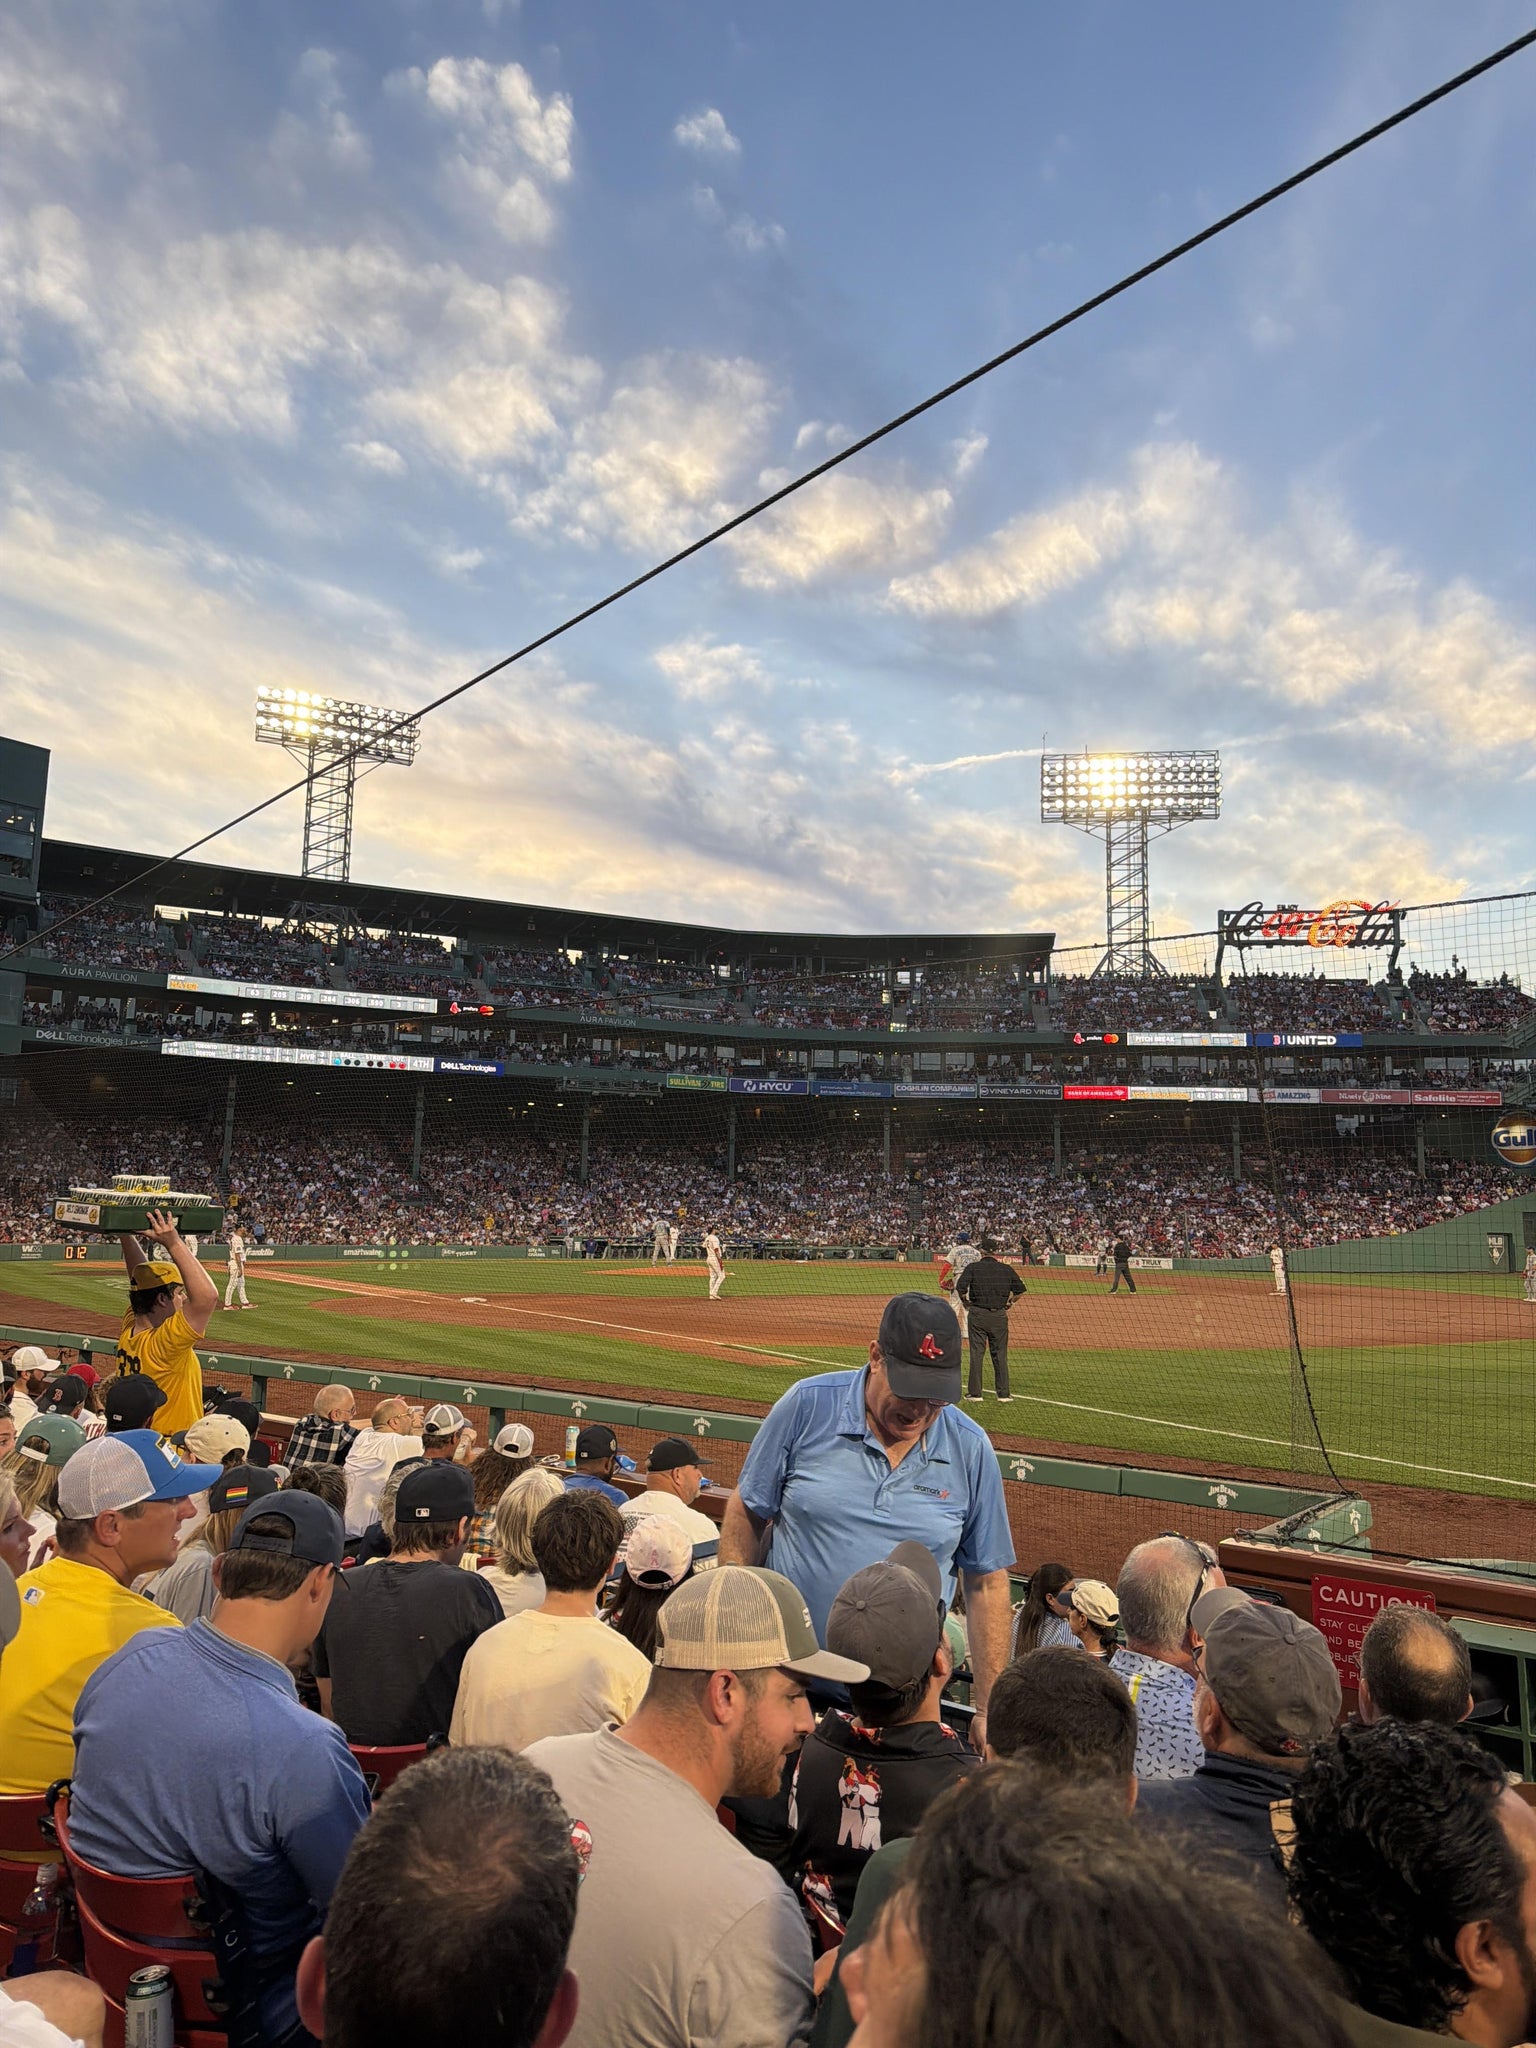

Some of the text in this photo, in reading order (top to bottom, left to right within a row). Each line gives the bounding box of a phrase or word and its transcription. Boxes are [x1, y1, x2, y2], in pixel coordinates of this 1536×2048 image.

[1226, 899, 1400, 948] Coca-Cola
[95, 970, 138, 982] PAVILION
[604, 1018, 636, 1026] PAVILION
[36, 1029, 65, 1040] DELL
[65, 1033, 123, 1047] Technologies
[1286, 1035, 1337, 1045] UNITED
[413, 1060, 429, 1068] 4TH
[669, 1079, 701, 1087] SULLIVAN
[759, 1082, 791, 1091] HYCU
[1414, 1094, 1456, 1102] Safelite
[1494, 1129, 1536, 1146] Gul
[914, 1484, 940, 1495] aramark
[1208, 1484, 1238, 1499] JIM BEAM
[1320, 1617, 1369, 1634] STAY CLE
[1330, 1652, 1355, 1664] OBJE
